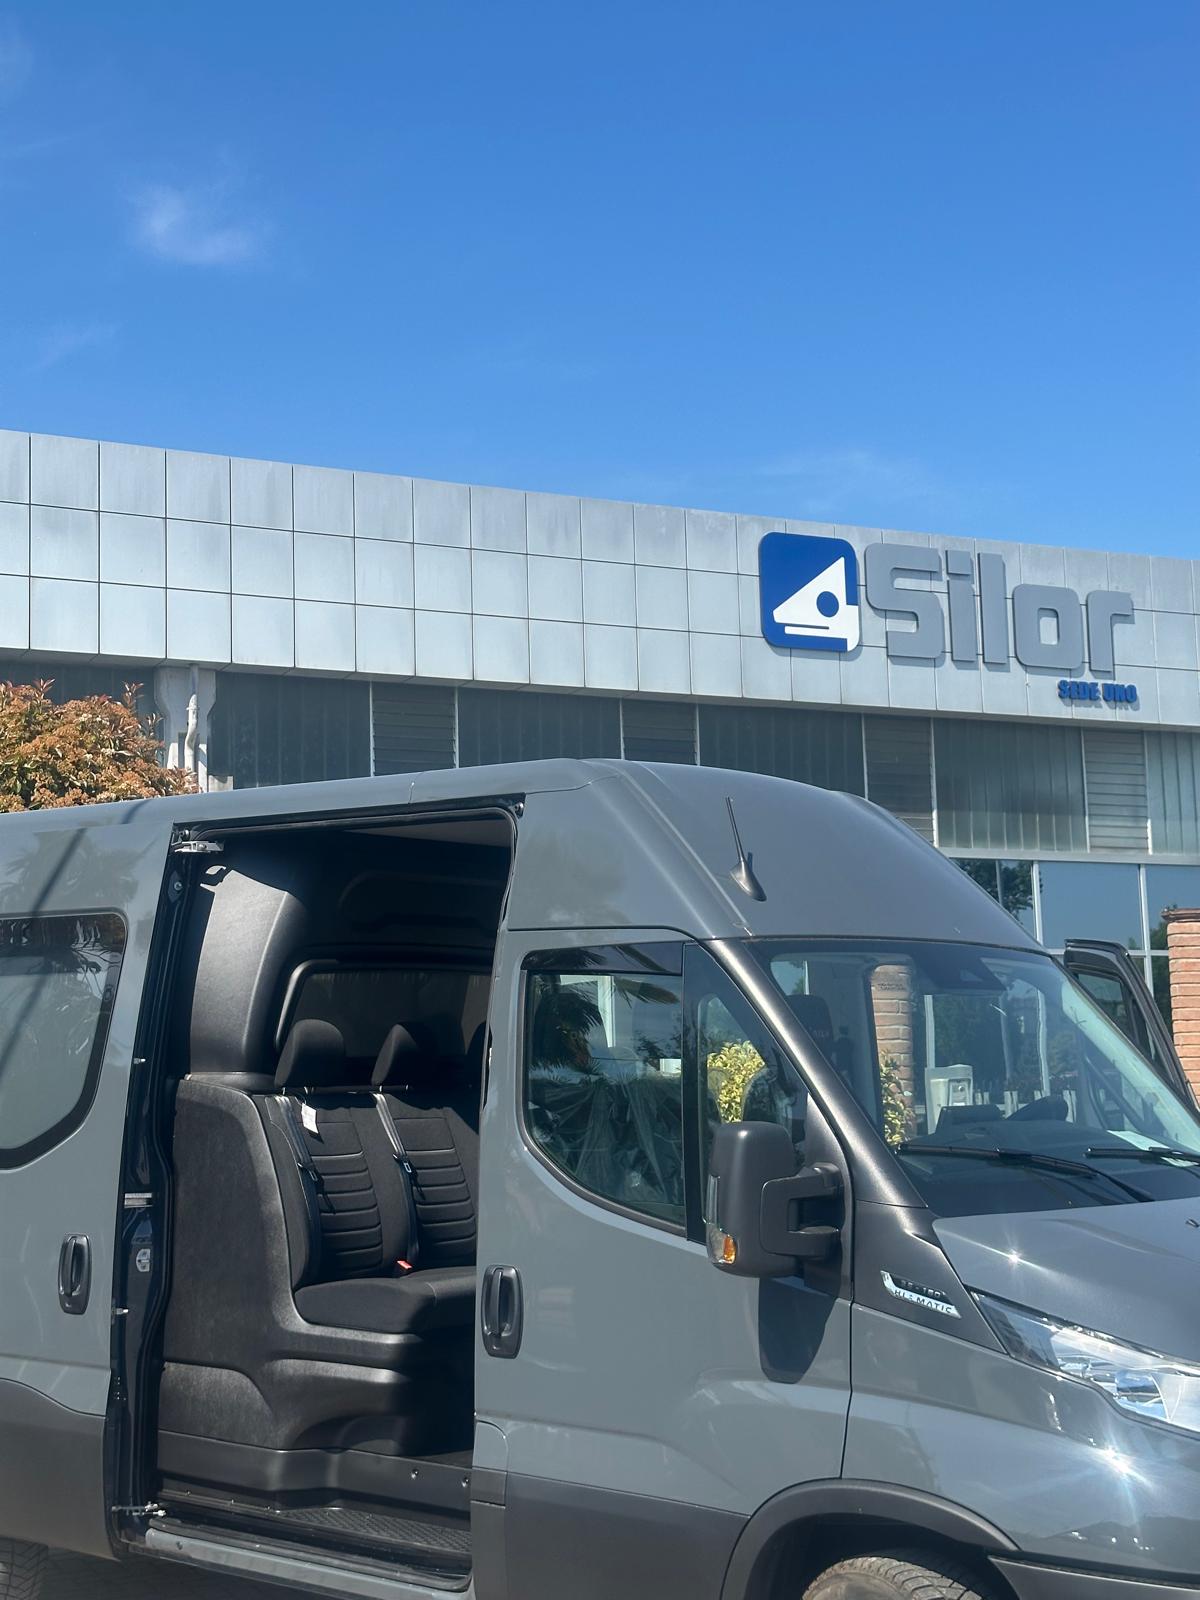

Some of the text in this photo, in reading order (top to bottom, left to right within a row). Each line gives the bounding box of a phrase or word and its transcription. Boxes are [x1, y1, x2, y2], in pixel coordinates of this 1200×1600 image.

[865, 543, 1134, 674] Silor
[1058, 680, 1137, 703] SEDE UNO
